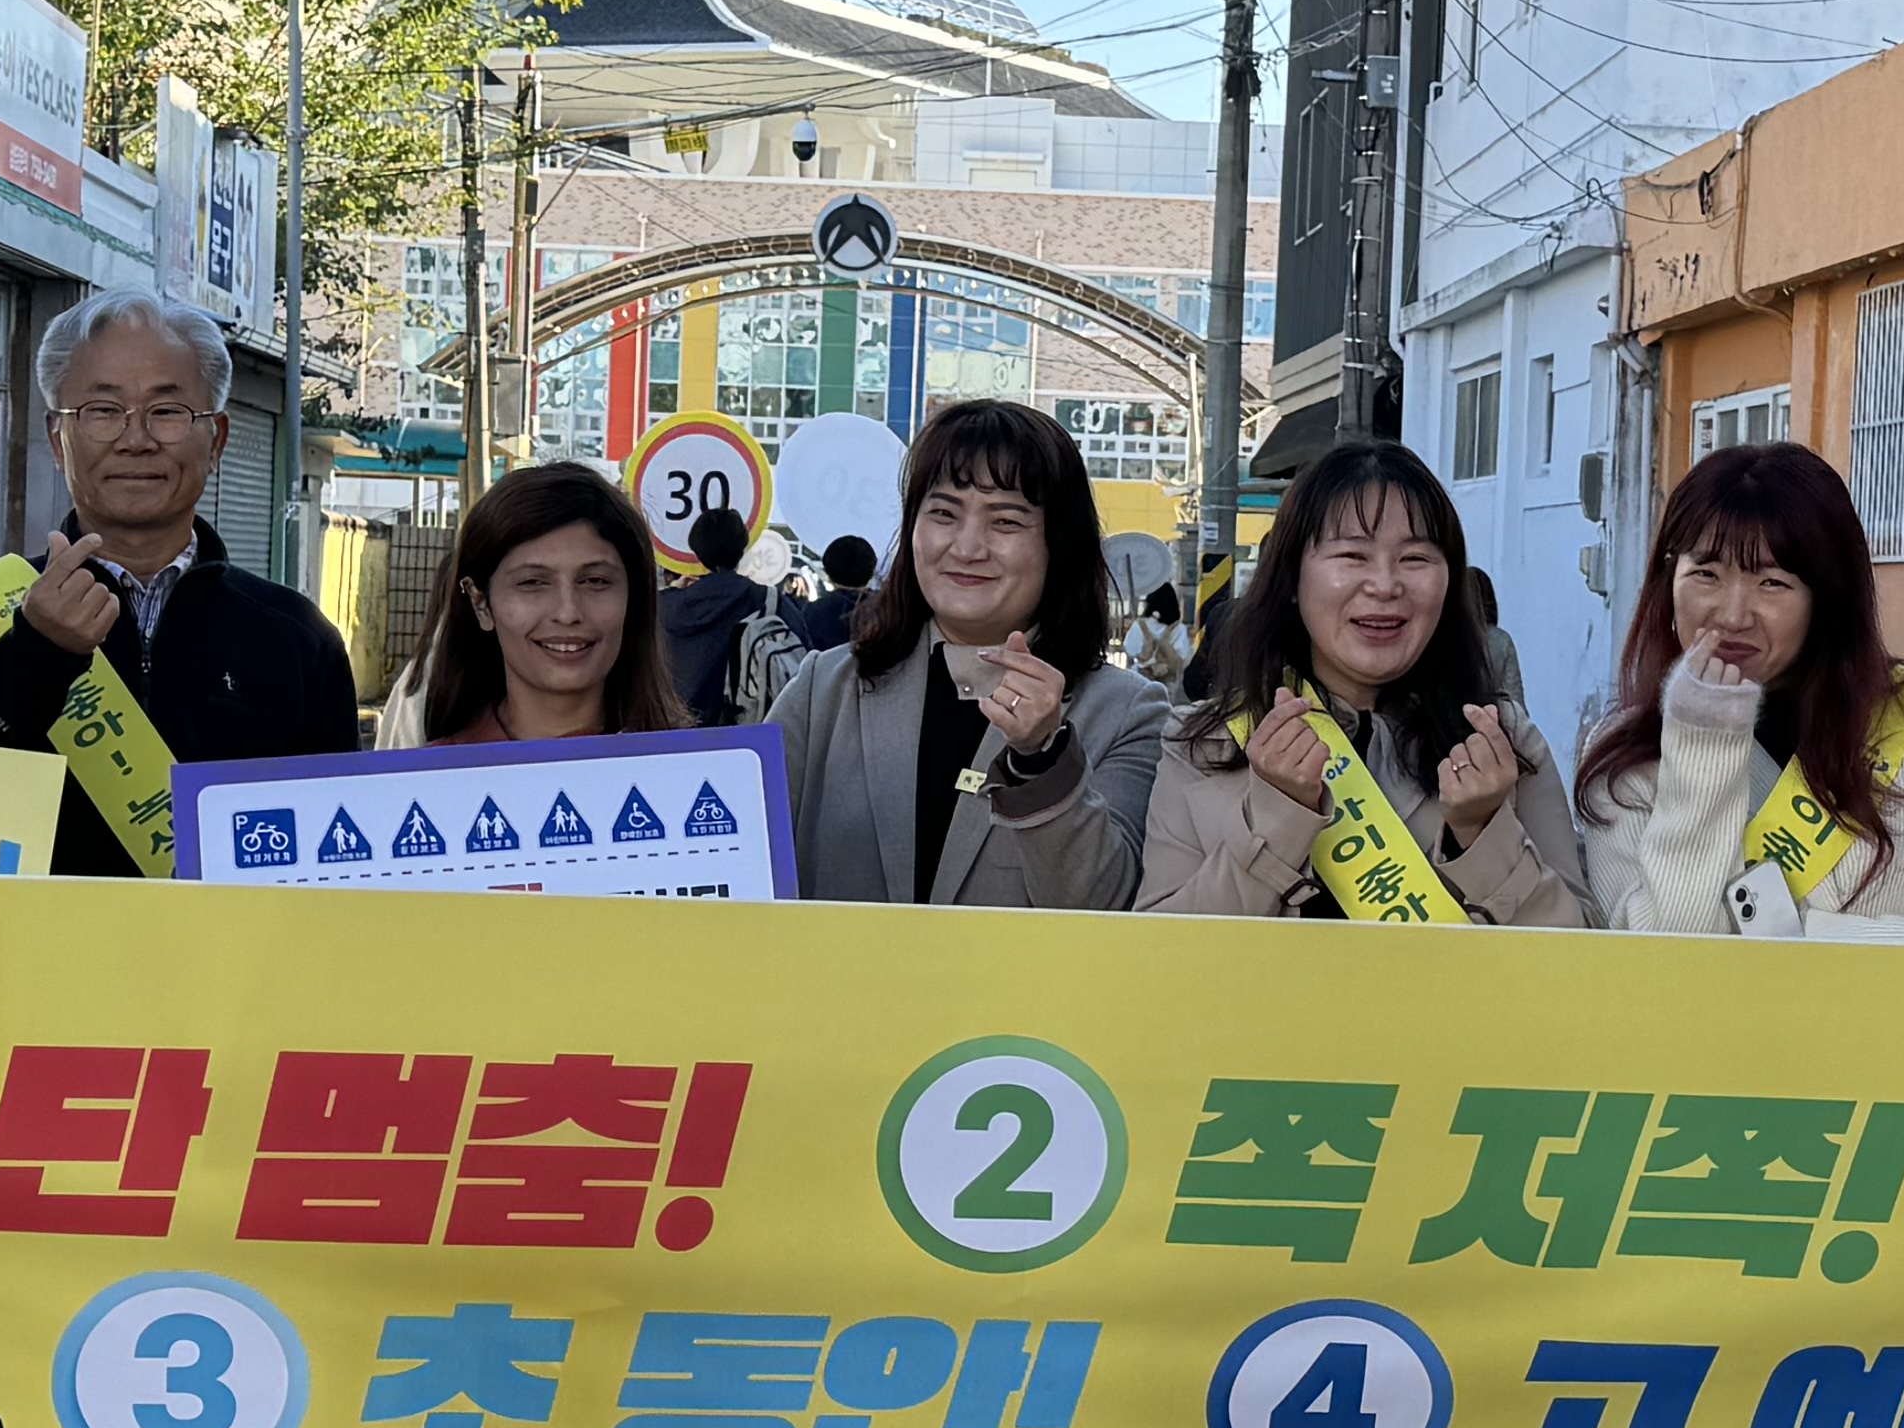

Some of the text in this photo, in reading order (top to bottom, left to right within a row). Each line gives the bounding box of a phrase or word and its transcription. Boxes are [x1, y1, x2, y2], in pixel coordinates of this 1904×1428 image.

[19, 53, 40, 106] YES
[42, 68, 77, 128] CLASS
[665, 470, 730, 521] 30
[235, 815, 248, 831] P
[235, 1052, 753, 1252] 멈춤!
[953, 1082, 1054, 1222] 2
[1165, 1078, 1400, 1262] 쪽
